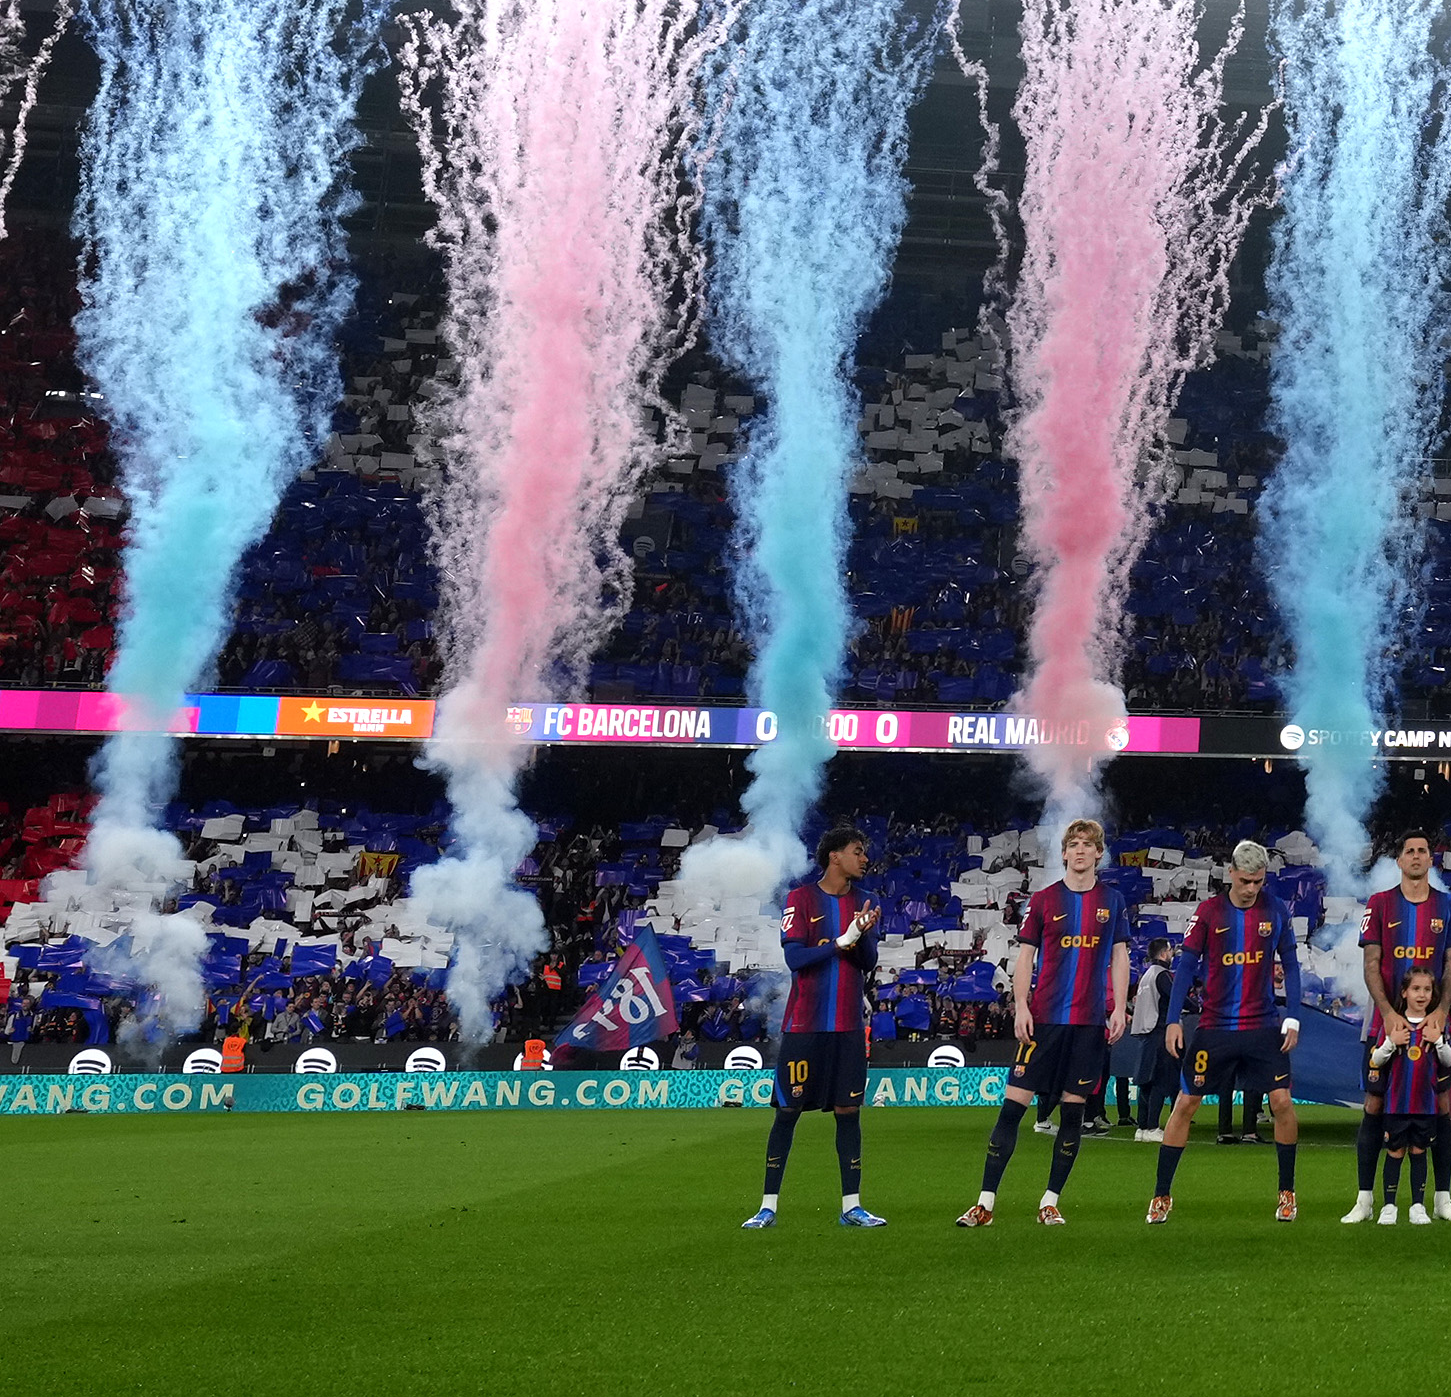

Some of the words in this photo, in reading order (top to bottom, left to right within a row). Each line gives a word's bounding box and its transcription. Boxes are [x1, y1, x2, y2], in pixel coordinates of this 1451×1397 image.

[327, 707, 412, 725] ESTRELLA
[543, 707, 574, 736] FC
[577, 708, 711, 739] BARCELONA
[756, 711, 778, 741] 0
[875, 713, 899, 744] 0
[947, 716, 1001, 744] REAL
[1384, 730, 1436, 748] CAMP
[1060, 935, 1101, 949] GOLF
[1394, 946, 1435, 960] GOLF
[1222, 951, 1264, 966] GOLF
[1015, 1040, 1038, 1064] 17
[1194, 1050, 1209, 1073] 8
[787, 1060, 809, 1085] 10
[0, 1083, 234, 1111] ANG.COM
[296, 1079, 671, 1111] GOLFWANG.COM
